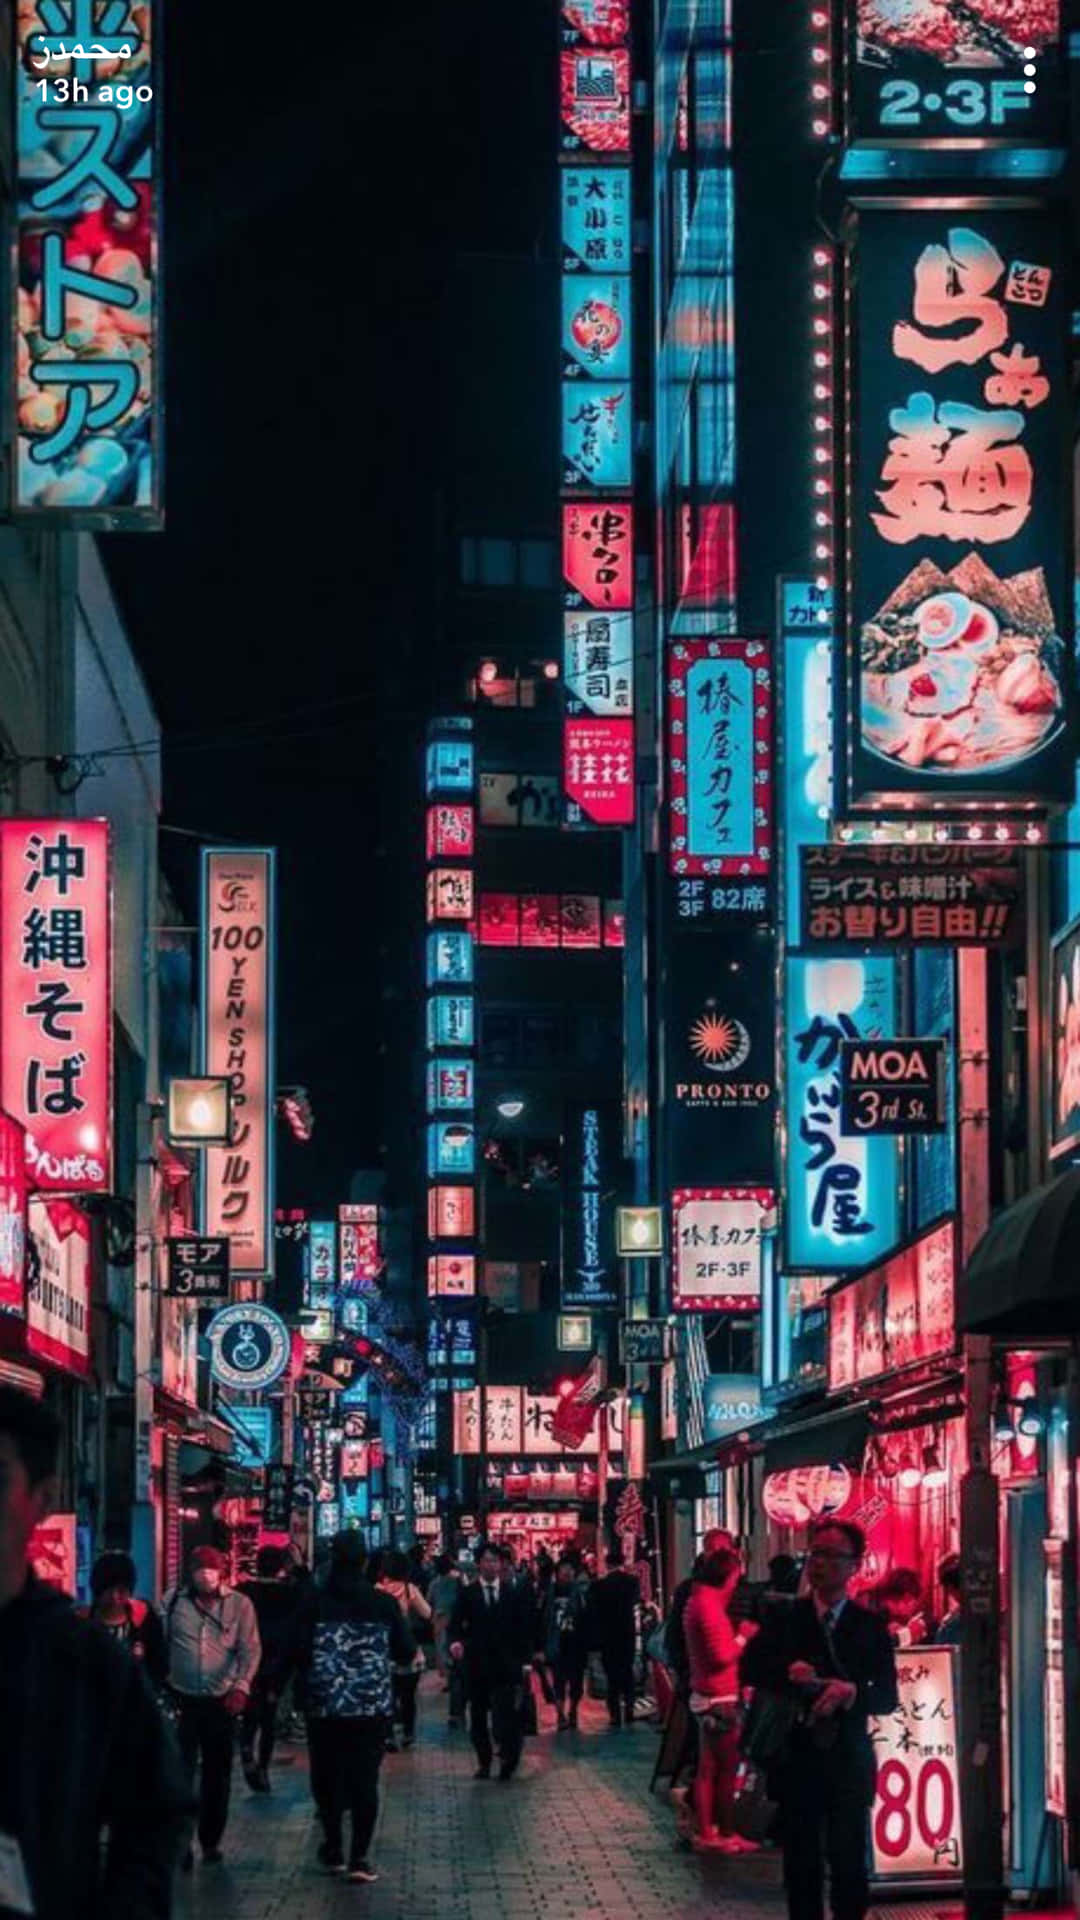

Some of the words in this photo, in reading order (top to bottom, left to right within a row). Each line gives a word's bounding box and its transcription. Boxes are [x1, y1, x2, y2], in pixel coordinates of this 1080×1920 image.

[565, 471, 581, 483] 3F
[564, 593, 582, 606] 2F
[567, 701, 583, 713] 1F
[569, 752, 630, 784] 桂花
[696, 672, 745, 845] 椿屋カフェ
[679, 882, 704, 898] 2F
[712, 887, 768, 913] 82席
[679, 901, 704, 918] 3F
[211, 926, 264, 952] 100
[23, 833, 87, 1115] 沖縄そば
[225, 957, 249, 1019] YEN
[226, 1028, 249, 1106] SHOP
[850, 1050, 929, 1081] MOA
[676, 1084, 771, 1100] PRONTO
[853, 1090, 901, 1129] 3rd
[583, 1110, 599, 1186] STEAK
[583, 1191, 599, 1267] HOUSE
[176, 1243, 221, 1264] モア
[623, 1325, 661, 1338] MOA
[524, 1400, 625, 1437] ねし
